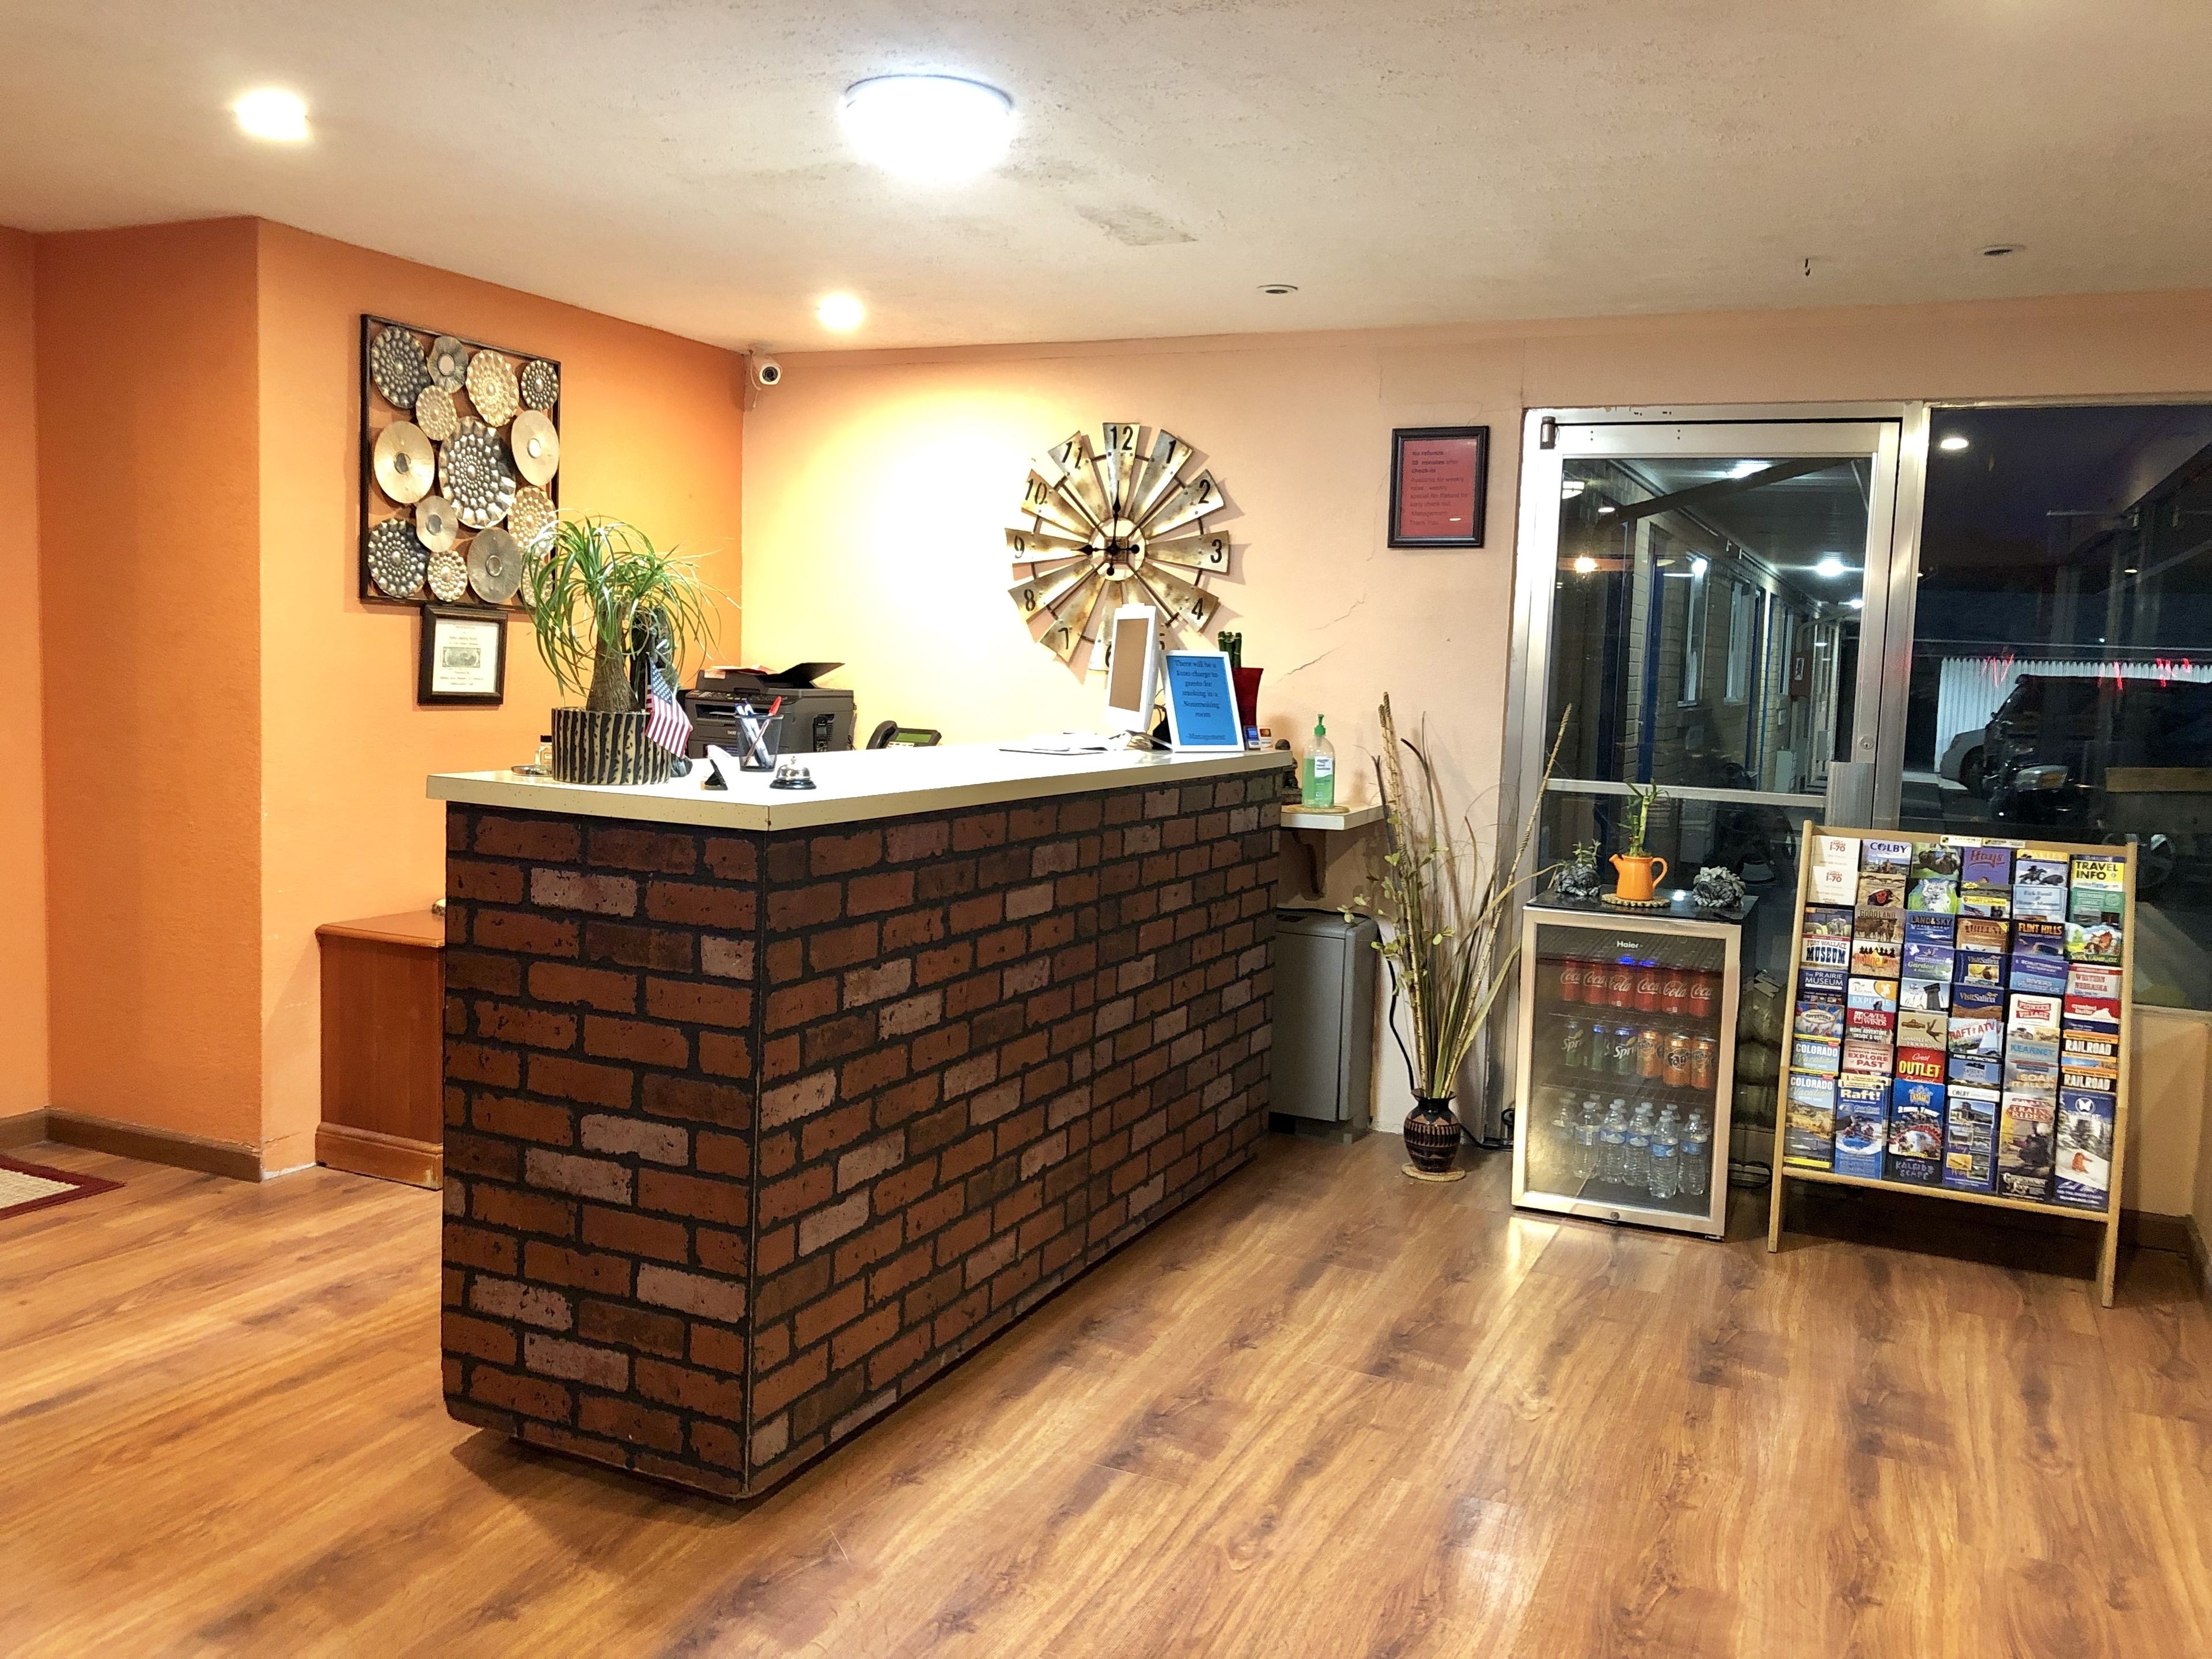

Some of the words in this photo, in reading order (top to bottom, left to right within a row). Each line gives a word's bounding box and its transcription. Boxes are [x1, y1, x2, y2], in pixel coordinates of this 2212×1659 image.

[1109, 425, 1134, 451] 12
[1062, 441, 1084, 468] 11
[1166, 440, 1177, 464] 1
[1024, 479, 1047, 505] 10
[1198, 479, 1210, 503] 2
[1014, 535, 1025, 559] 9
[1210, 539, 1223, 563] 3
[1024, 589, 1036, 611] 8
[1191, 597, 1203, 620] 4
[1058, 627, 1070, 650] 7
[1192, 670, 1211, 679] charge
[1870, 842, 1908, 853] COLBY
[1969, 849, 2004, 868] Hays
[2075, 861, 2118, 872] TRAVEL
[2076, 870, 2107, 880] INFO
[1859, 910, 1896, 918] GOODLAND
[2018, 922, 2040, 933] FLINT
[2041, 924, 2062, 935] HILLS
[1616, 941, 1639, 949] Haier
[1821, 941, 1847, 950] WALLACE
[1806, 946, 1846, 964] MUSEUM
[1584, 971, 1606, 988] Coca
[1805, 976, 1844, 986] MUSEUM
[1815, 972, 1843, 980] PRAIRIE
[1637, 978, 1660, 995] Coca
[1662, 980, 1688, 998] Cola
[1690, 982, 1714, 1001] Coca
[1863, 1018, 1887, 1027] WINDS
[1948, 1027, 1971, 1040] RAFT
[1796, 1043, 1839, 1057] COLORADO
[2010, 1043, 2055, 1056] KEARNEY
[2065, 1039, 2112, 1056] RAILROAD
[1848, 1052, 1889, 1062] EXPLORE
[1967, 1055, 1998, 1063] ATTRACTION
[1856, 1059, 1885, 1069] PAST
[1899, 1060, 1941, 1078] OUTLET
[1790, 1077, 1833, 1090] COLORADO
[2063, 1073, 2111, 1091] RAILROAD
[1840, 1089, 1881, 1101] Raft!
[2011, 1105, 2047, 1116] TRAIN
[2011, 1112, 2046, 1120] RIDES
